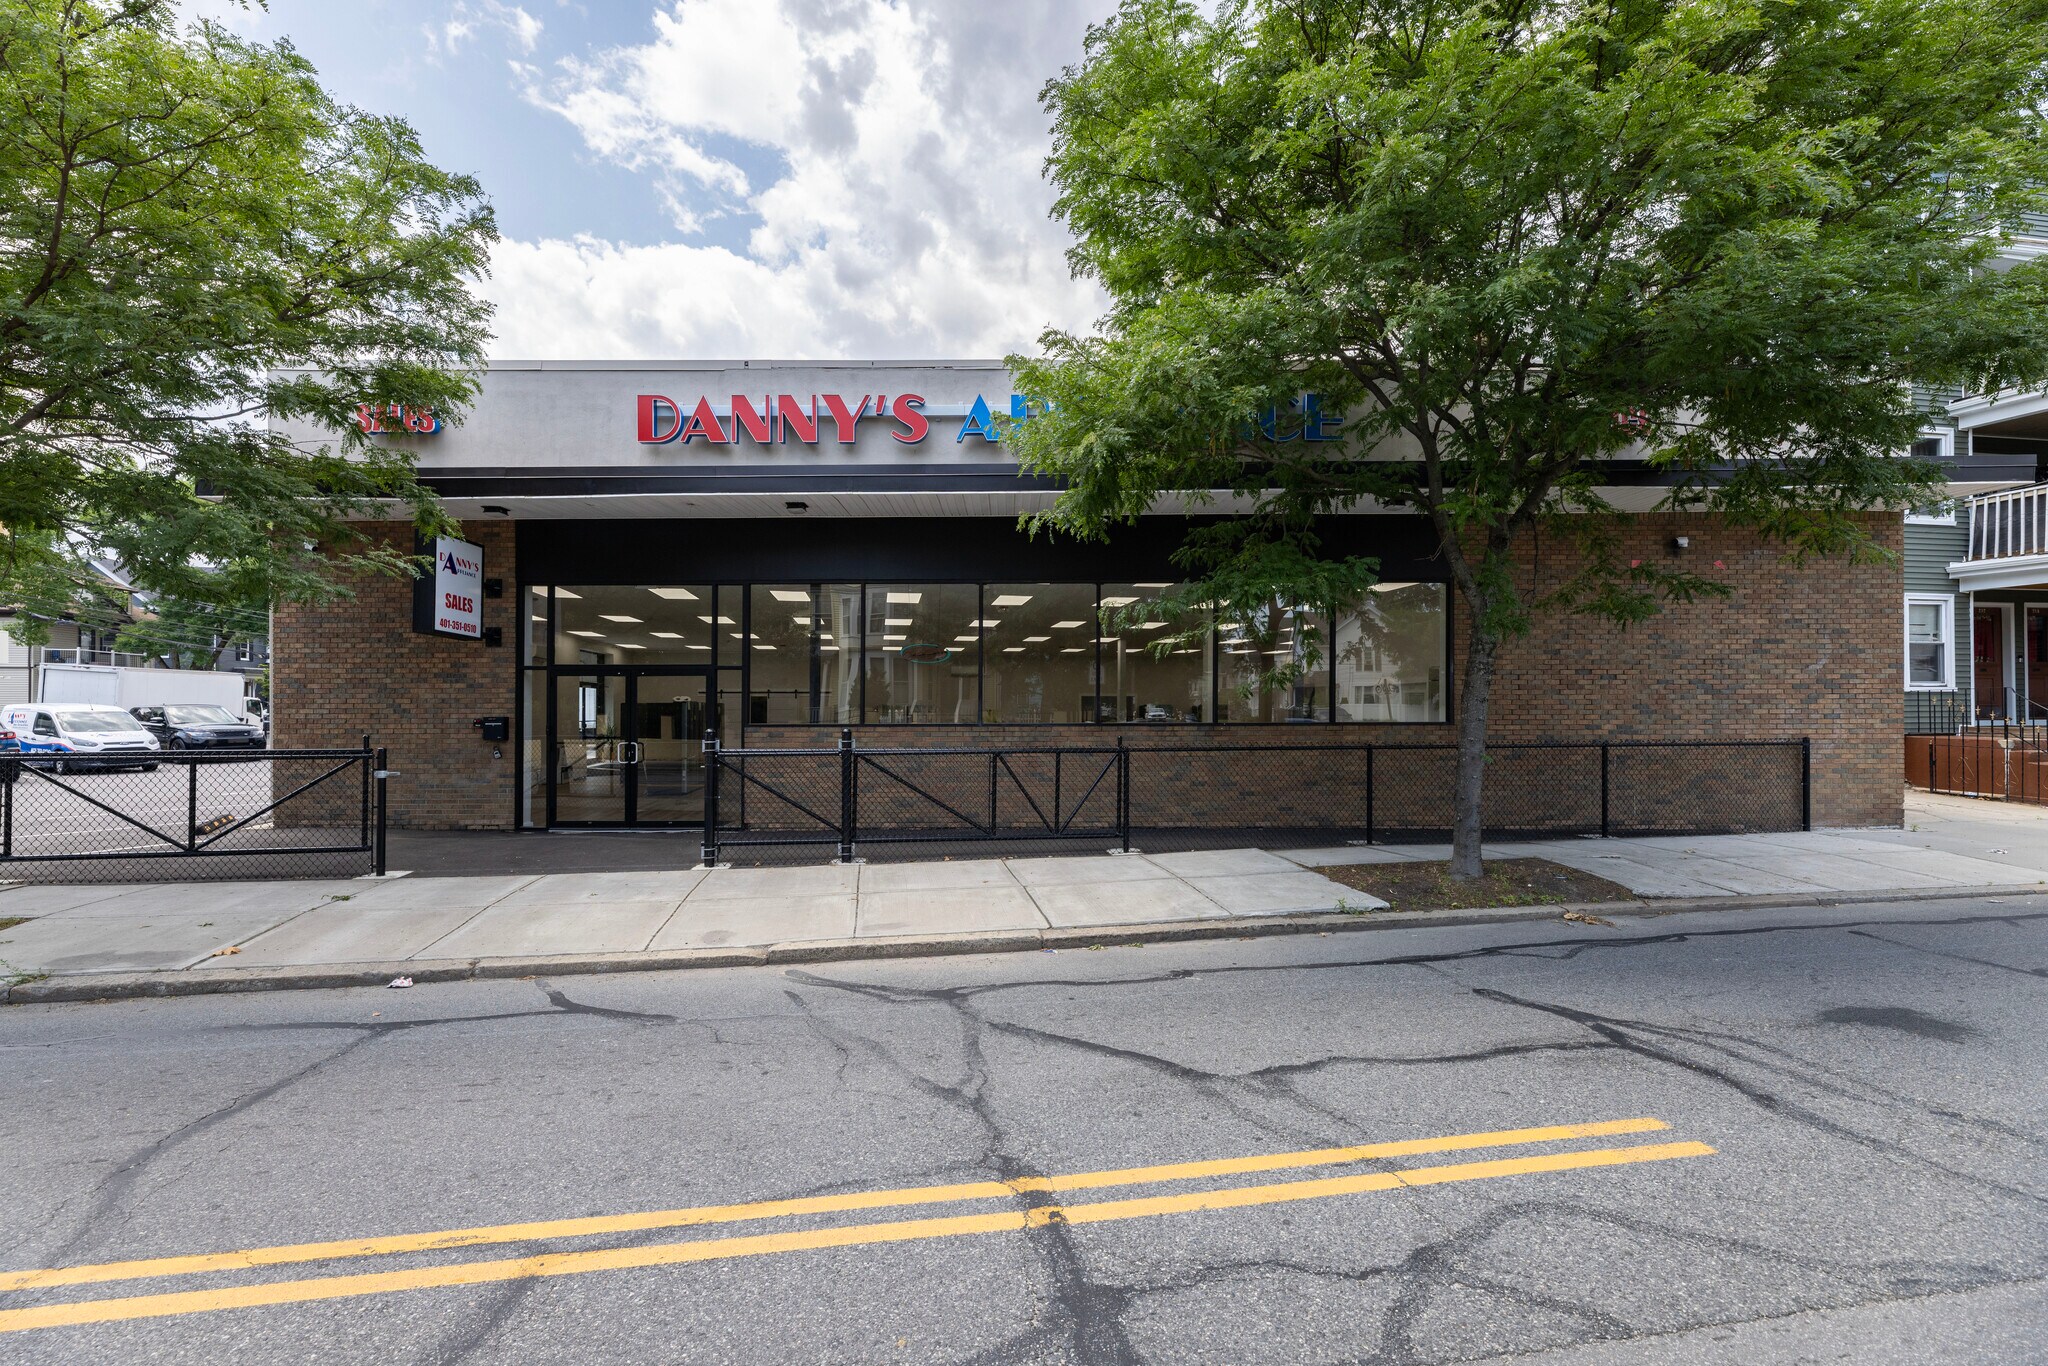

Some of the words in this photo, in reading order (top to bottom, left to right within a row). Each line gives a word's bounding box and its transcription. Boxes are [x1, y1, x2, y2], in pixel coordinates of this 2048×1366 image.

[636, 393, 931, 444] DANNY'S
[439, 551, 479, 575] DANNY'S
[445, 592, 473, 613] SALES
[440, 618, 477, 634] 401-351-0510
